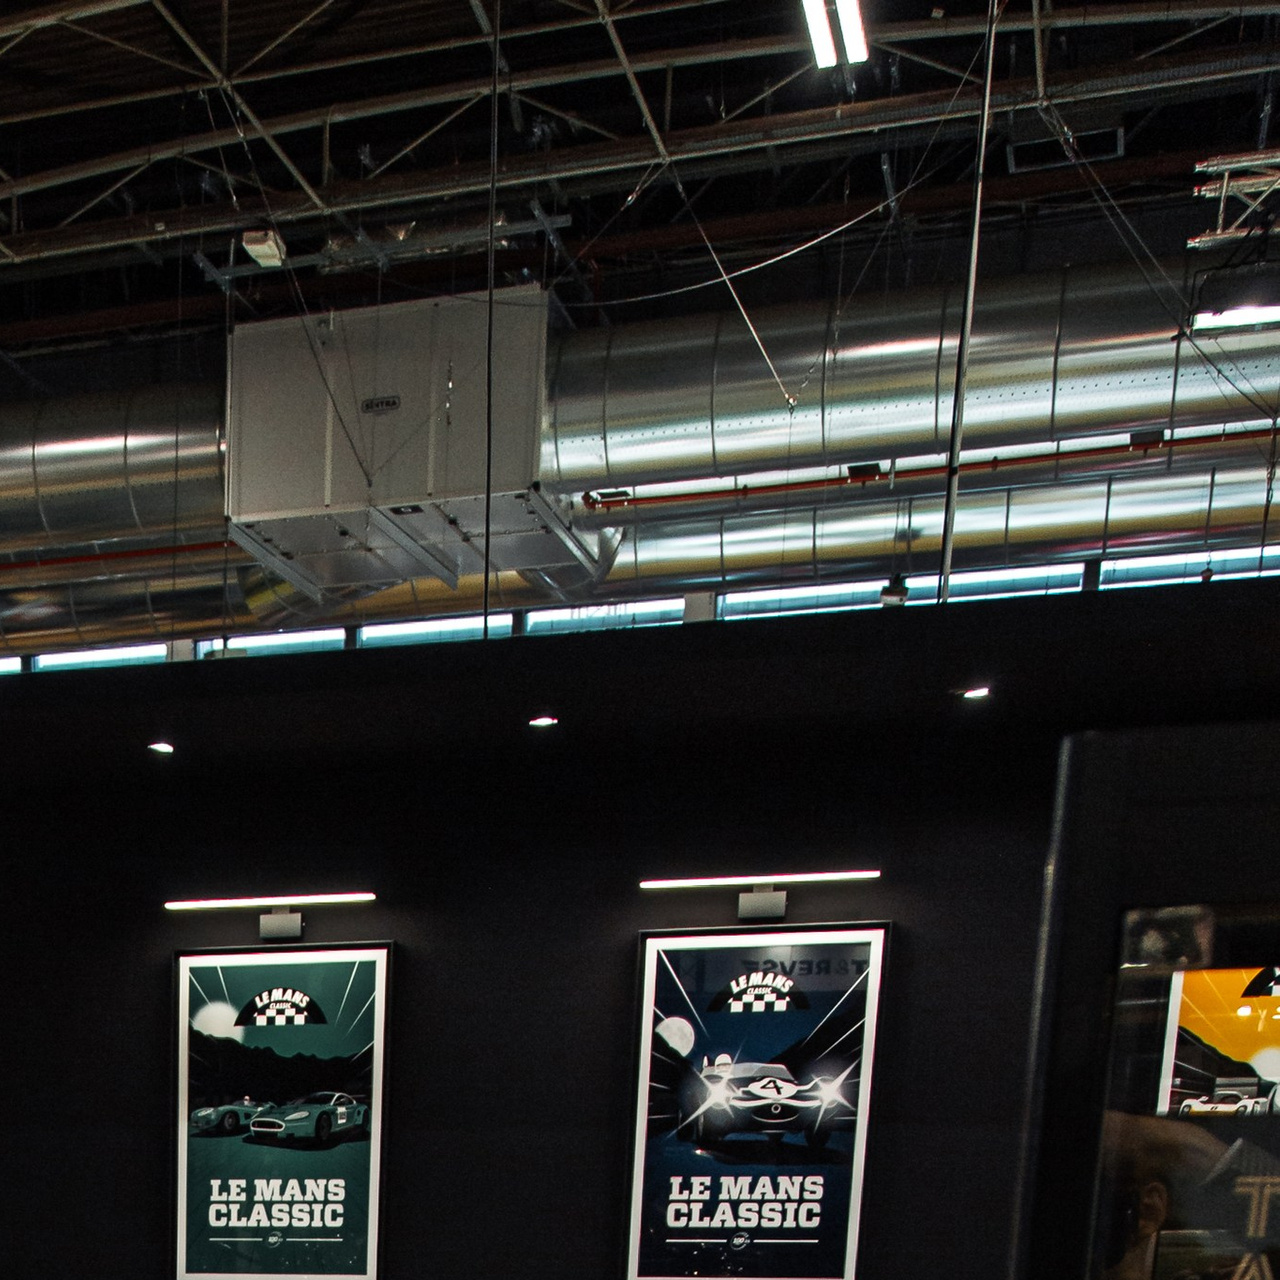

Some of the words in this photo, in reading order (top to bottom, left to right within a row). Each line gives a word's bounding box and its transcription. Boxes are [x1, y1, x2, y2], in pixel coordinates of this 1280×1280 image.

[730, 972, 748, 993] LE
[747, 971, 794, 993] MANS
[254, 991, 270, 1008] LE
[271, 987, 310, 1008] MANS
[760, 1080, 783, 1095] 4
[210, 1179, 246, 1201] LE
[254, 1179, 345, 1201] MANS
[669, 1176, 711, 1200] LE
[719, 1176, 824, 1200] MANS
[208, 1203, 344, 1227] CLASSIC
[666, 1202, 821, 1228] CLASSIC
